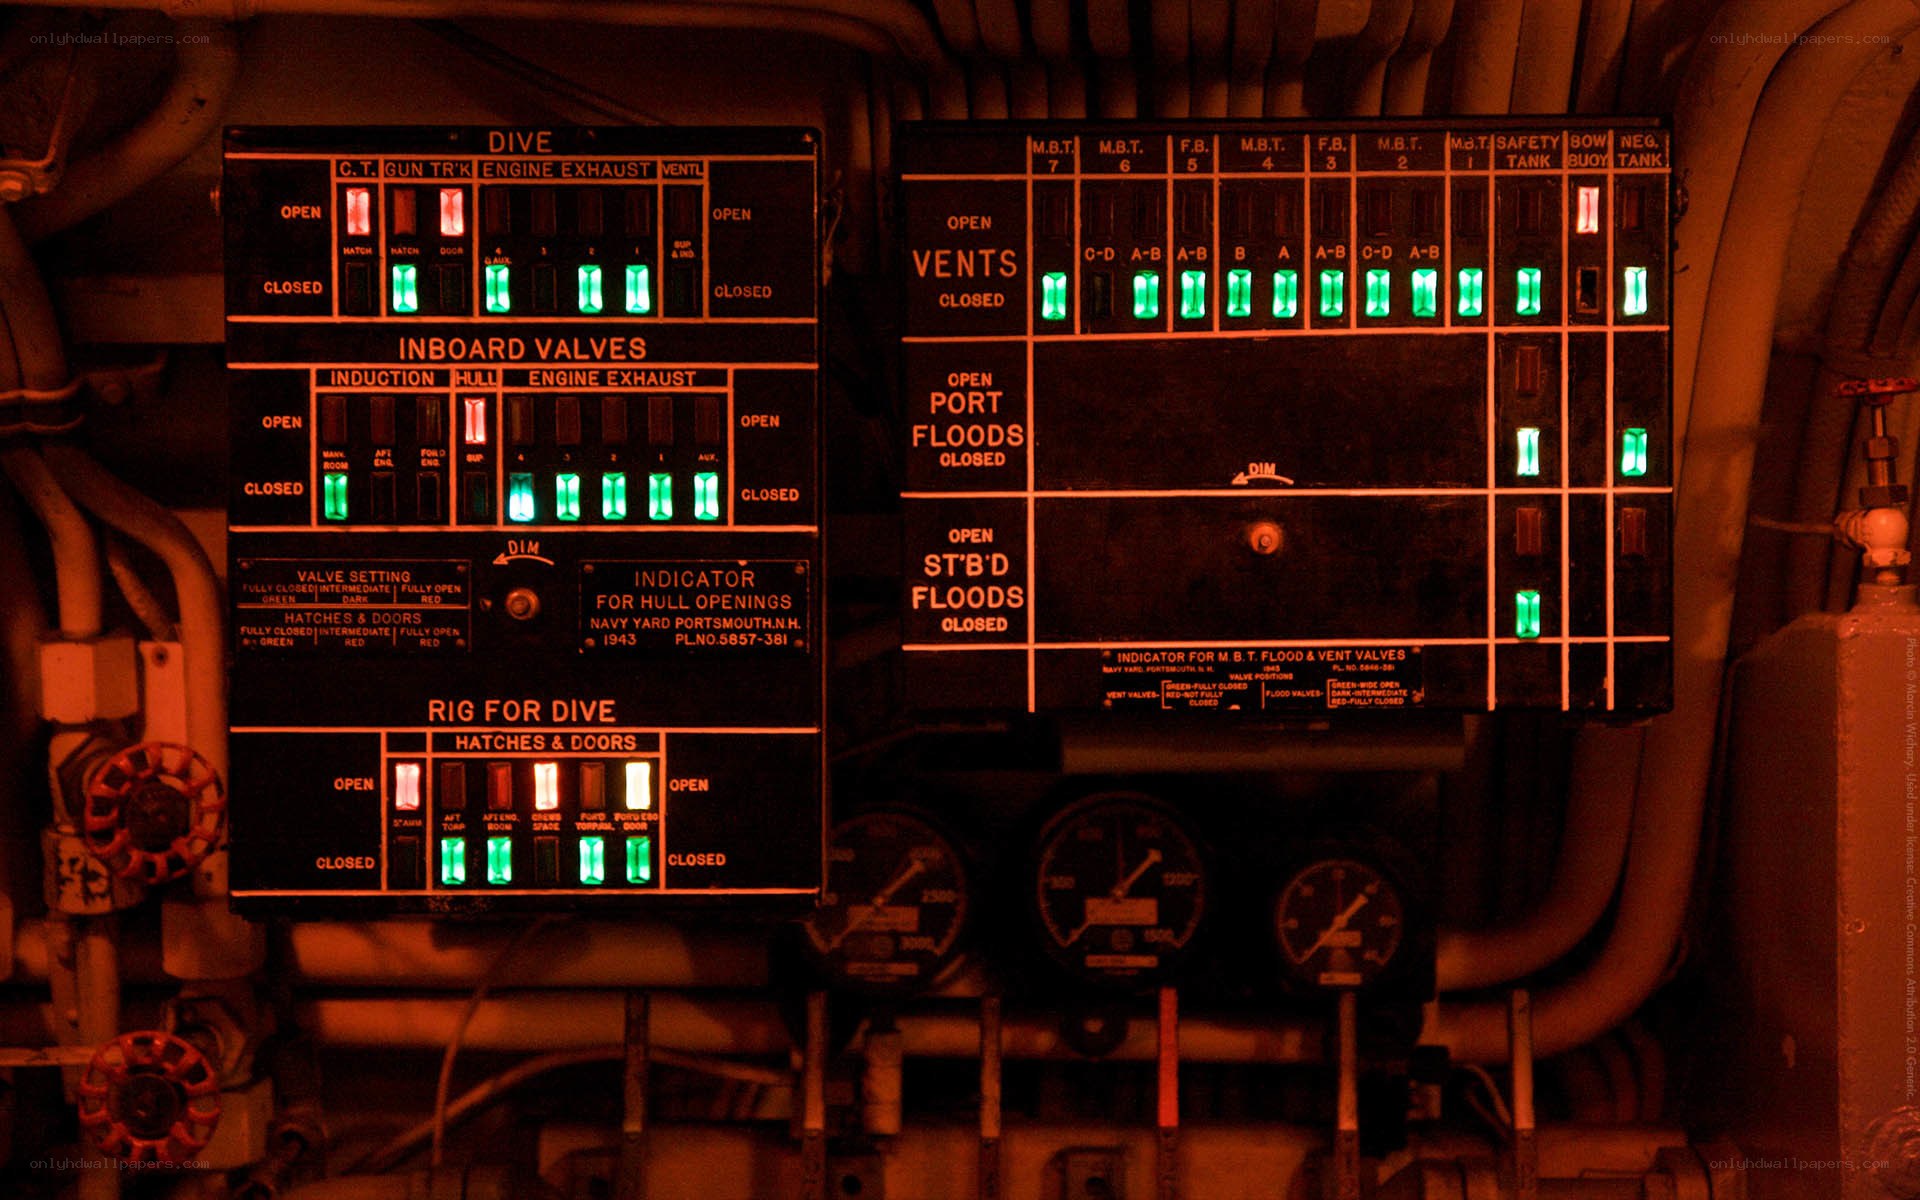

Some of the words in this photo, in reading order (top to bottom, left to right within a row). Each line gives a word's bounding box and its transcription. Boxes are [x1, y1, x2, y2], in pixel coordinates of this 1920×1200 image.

[489, 130, 552, 153] DIVE
[1181, 140, 1209, 153] F.B.
[1318, 138, 1346, 151] F.B.
[1497, 136, 1560, 149] SAFETY
[1570, 135, 1606, 148] BOW
[1621, 135, 1659, 148] NEG.
[1049, 160, 1059, 172] 7
[1120, 160, 1130, 172] 6
[1187, 158, 1198, 171] 5
[1262, 156, 1274, 170] 4
[1327, 157, 1336, 170] 3
[1398, 156, 1408, 169] 2
[1468, 157, 1472, 169] 1
[1507, 155, 1551, 168] TANK
[1568, 154, 1609, 167] BUOY
[1618, 154, 1662, 167] TANK
[385, 162, 424, 177] GUN
[430, 162, 472, 177] TR'K
[483, 162, 553, 177] ENGINE
[562, 162, 651, 177] EXHAUST
[281, 206, 322, 219] OPEN
[712, 208, 752, 221] OPEN
[947, 216, 992, 230] OPEN
[1084, 247, 1115, 261] C-D
[1131, 247, 1161, 261] A-B
[1177, 247, 1208, 260] A-B
[1235, 247, 1245, 260] B
[1278, 246, 1290, 259] A
[1316, 246, 1346, 259] A-B
[1362, 246, 1393, 260] C-D
[1409, 245, 1439, 259] A-B
[913, 249, 1017, 278] VENTS
[264, 281, 323, 294] CLOSED
[714, 286, 772, 298] CLOSED
[939, 293, 1005, 307] CLOSED
[400, 337, 525, 360] INBOARD
[534, 337, 647, 360] VALVES
[331, 371, 434, 386] INDUCTION
[456, 371, 497, 386] HULL
[529, 371, 599, 386] ENGINE
[607, 371, 696, 386] EXHAUST
[948, 372, 992, 387] OPEN
[930, 391, 1003, 414] PORT
[262, 415, 302, 428] OPEN
[740, 415, 780, 427] OPEN
[912, 424, 1024, 447] FLOODS
[940, 452, 1006, 467] CLOSED
[1249, 463, 1276, 475] DIM
[244, 482, 304, 495] CLOSED
[741, 488, 799, 501] CLOSED
[948, 528, 993, 543] OPEN
[508, 540, 540, 554] DIM
[924, 553, 1009, 576] ST'B'D
[298, 571, 344, 582] VALVE
[350, 571, 411, 583] SETTING
[634, 570, 756, 588] INDICATOR
[242, 584, 274, 593] FULLY
[276, 584, 314, 593] CLOSED
[319, 584, 391, 593] INTERMEDIATE
[402, 584, 432, 593] FULLY
[433, 584, 461, 593] OPEN
[261, 595, 296, 603] GREEN
[342, 595, 368, 603] DARK
[421, 595, 442, 603] RED
[596, 595, 634, 609] FOR
[640, 595, 690, 609] HULL
[696, 595, 792, 609] OPENINGS
[912, 586, 1024, 609] FLOODS
[285, 613, 352, 624] HATCHES
[358, 613, 366, 624] &
[372, 613, 423, 625] DOORS
[590, 617, 628, 629] NAVY
[633, 617, 671, 629] YARD
[941, 617, 1008, 632] CLOSED
[240, 627, 273, 636] FULLY
[274, 627, 312, 636] CLOSED
[319, 627, 391, 636] INTERMEDIATE
[400, 627, 431, 636] FULLY
[433, 627, 460, 636] OPEN
[260, 638, 294, 647] GREEN
[345, 638, 365, 647] RED
[420, 638, 440, 647] RED
[604, 634, 637, 645] 1943
[1117, 652, 1185, 663] INDICATOR
[1189, 652, 1214, 662] FOR
[1262, 651, 1303, 662] FLOOD
[1306, 651, 1315, 662] &
[1318, 651, 1352, 661] VENT
[1355, 650, 1406, 661] VALVES
[428, 699, 475, 722] RIG
[484, 699, 540, 722] FOR
[552, 699, 616, 722] DIVE
[455, 735, 545, 750] HATCHES
[551, 735, 564, 750] &
[571, 735, 637, 750] DOORS
[333, 777, 374, 791] OPEN
[669, 778, 709, 792] OPEN
[316, 857, 375, 870] CLOSED
[668, 854, 726, 866] CLOSED
